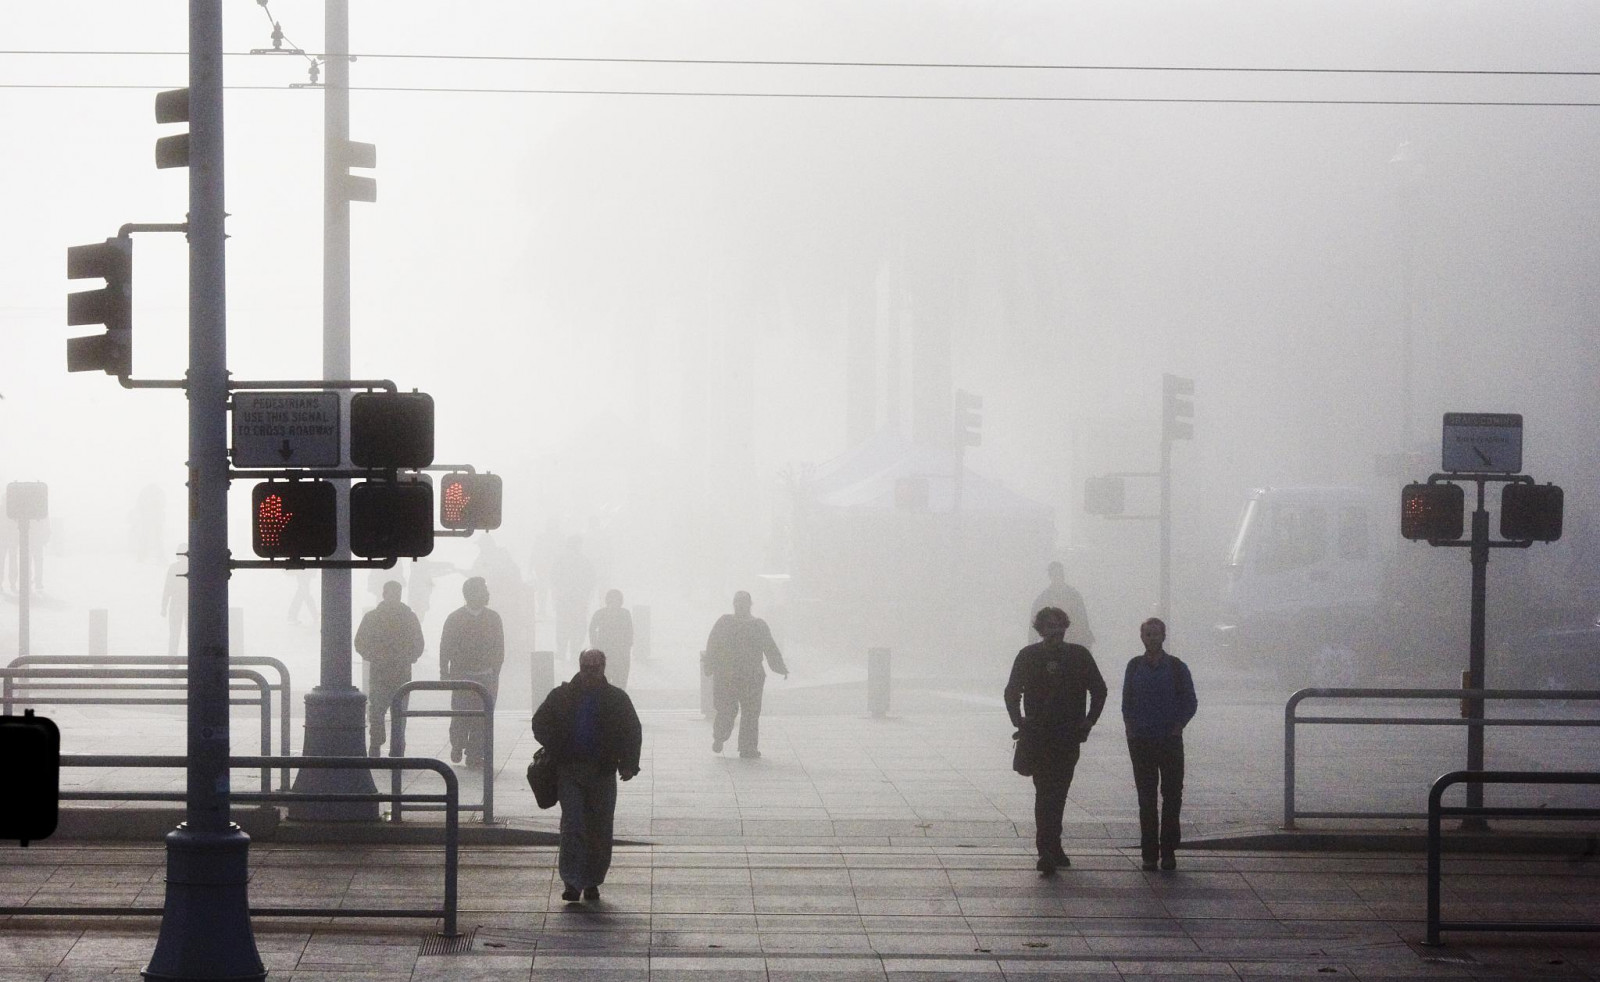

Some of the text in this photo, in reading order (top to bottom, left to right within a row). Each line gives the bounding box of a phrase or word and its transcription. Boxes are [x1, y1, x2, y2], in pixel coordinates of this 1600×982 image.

[253, 398, 319, 409] PEDESTRIANS
[243, 411, 329, 422] USE THIS SIGNAL
[238, 425, 334, 437] TO CROSS ROADWAY
